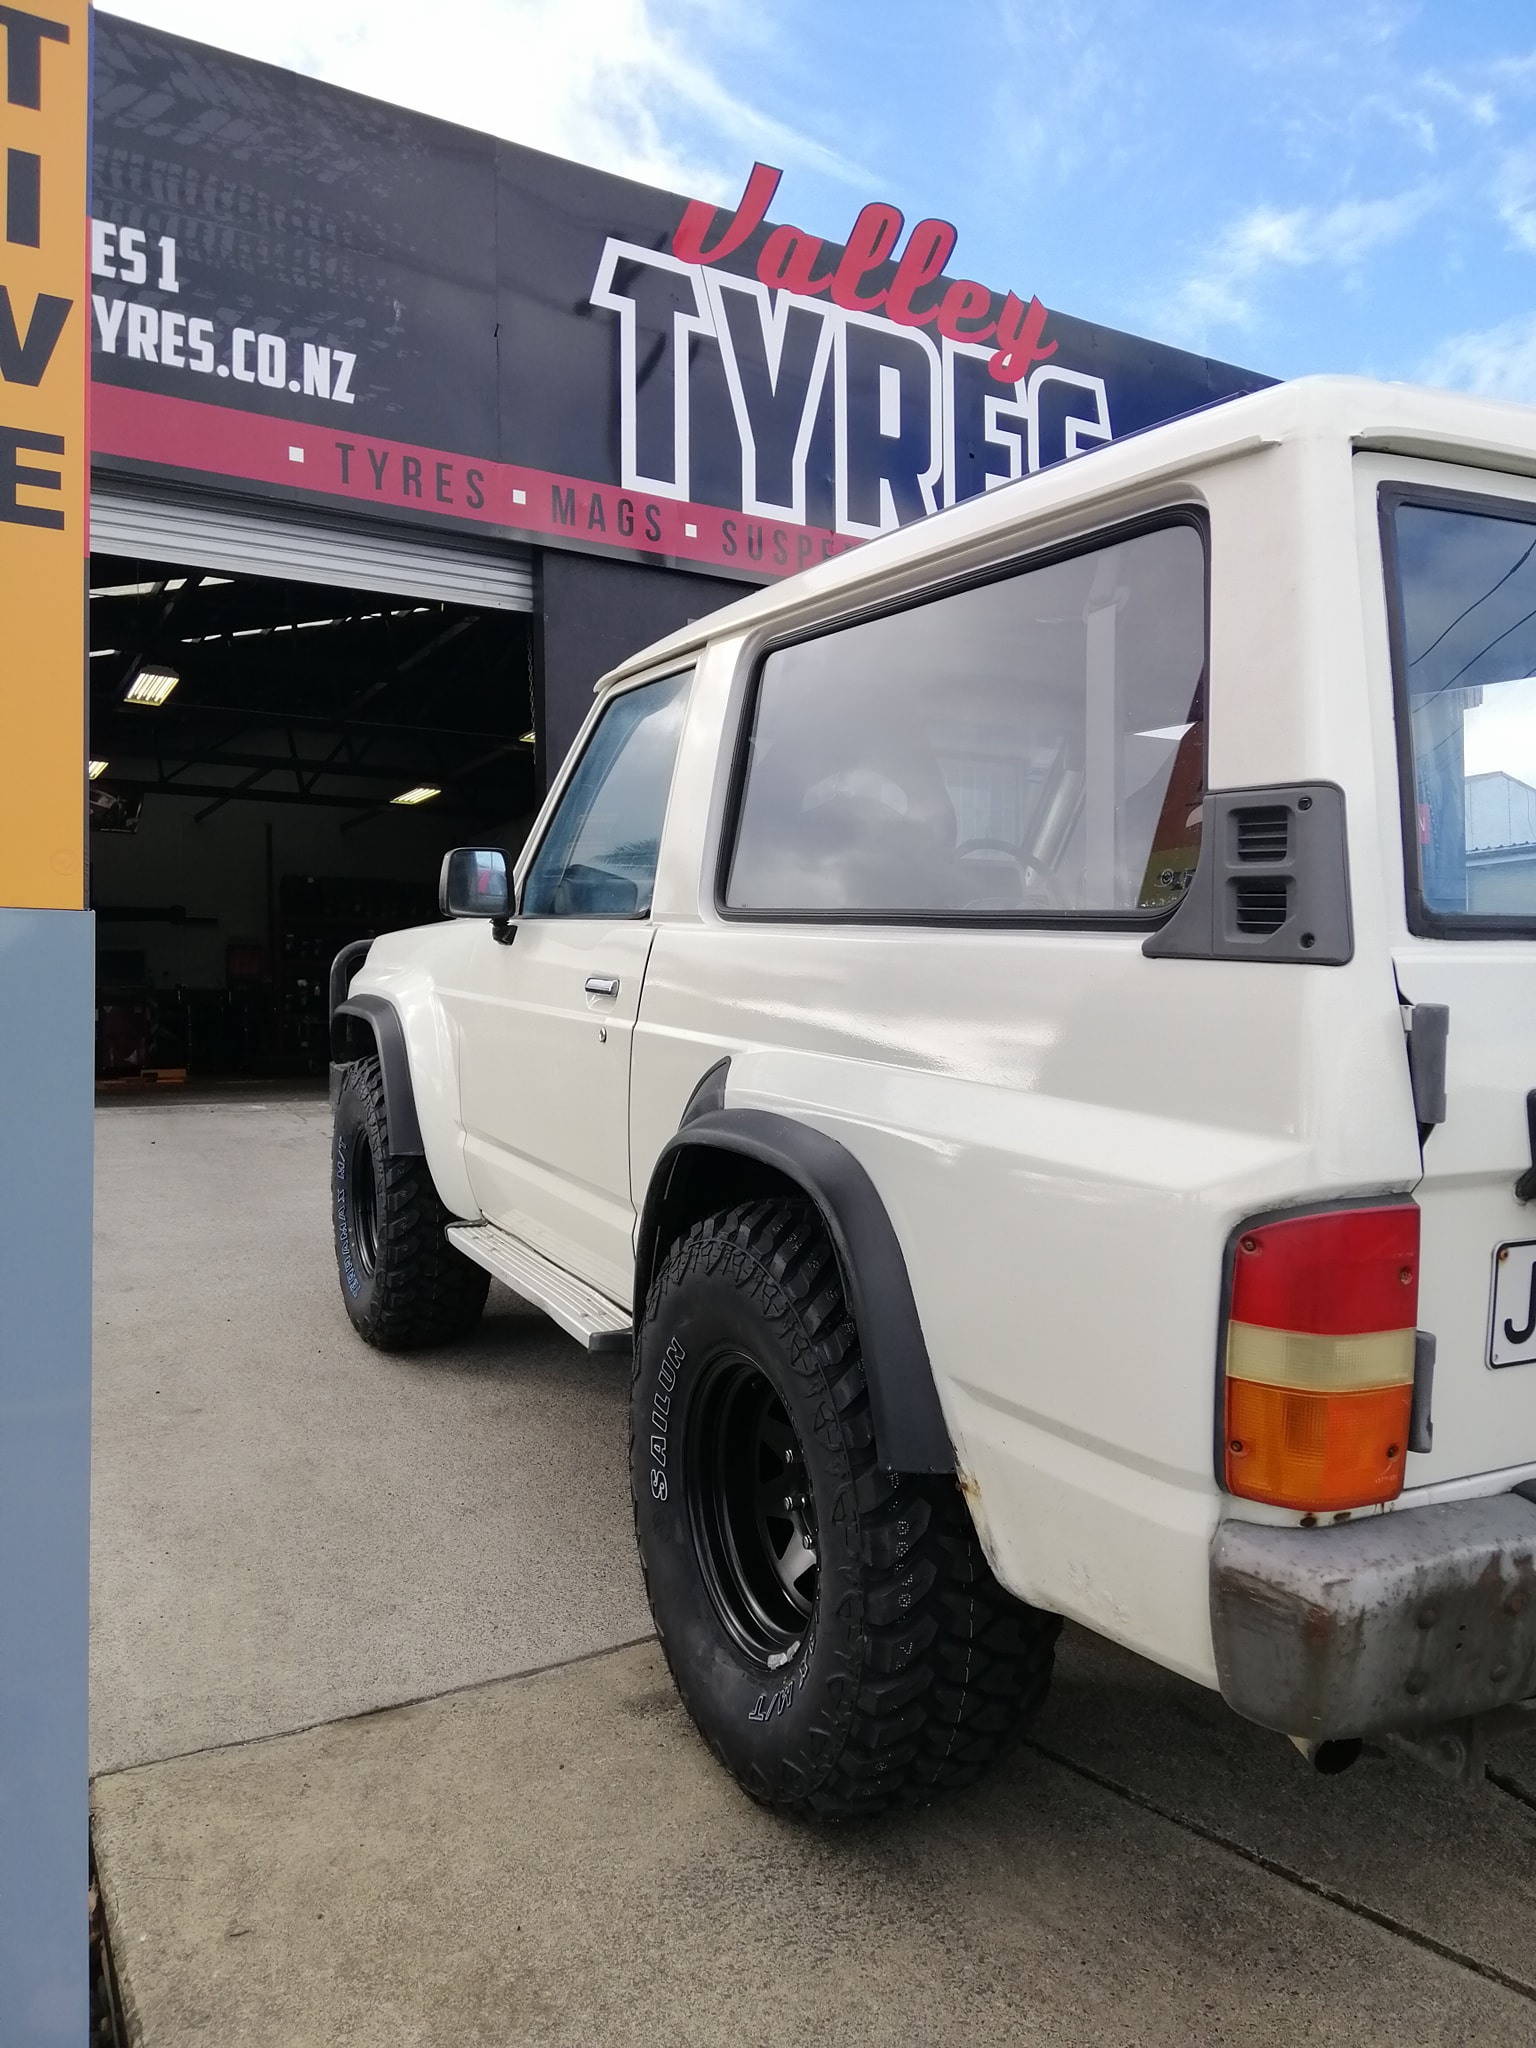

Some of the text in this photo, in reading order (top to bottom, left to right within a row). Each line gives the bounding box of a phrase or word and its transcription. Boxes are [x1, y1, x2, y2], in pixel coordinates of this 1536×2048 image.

[158, 235, 180, 293] 1
[672, 161, 1058, 383] Valley
[92, 295, 357, 404] YRES.CO.NZ
[336, 442, 852, 572] TYRES MAGS SUSPE
[649, 1336, 687, 1502] SAILUN
